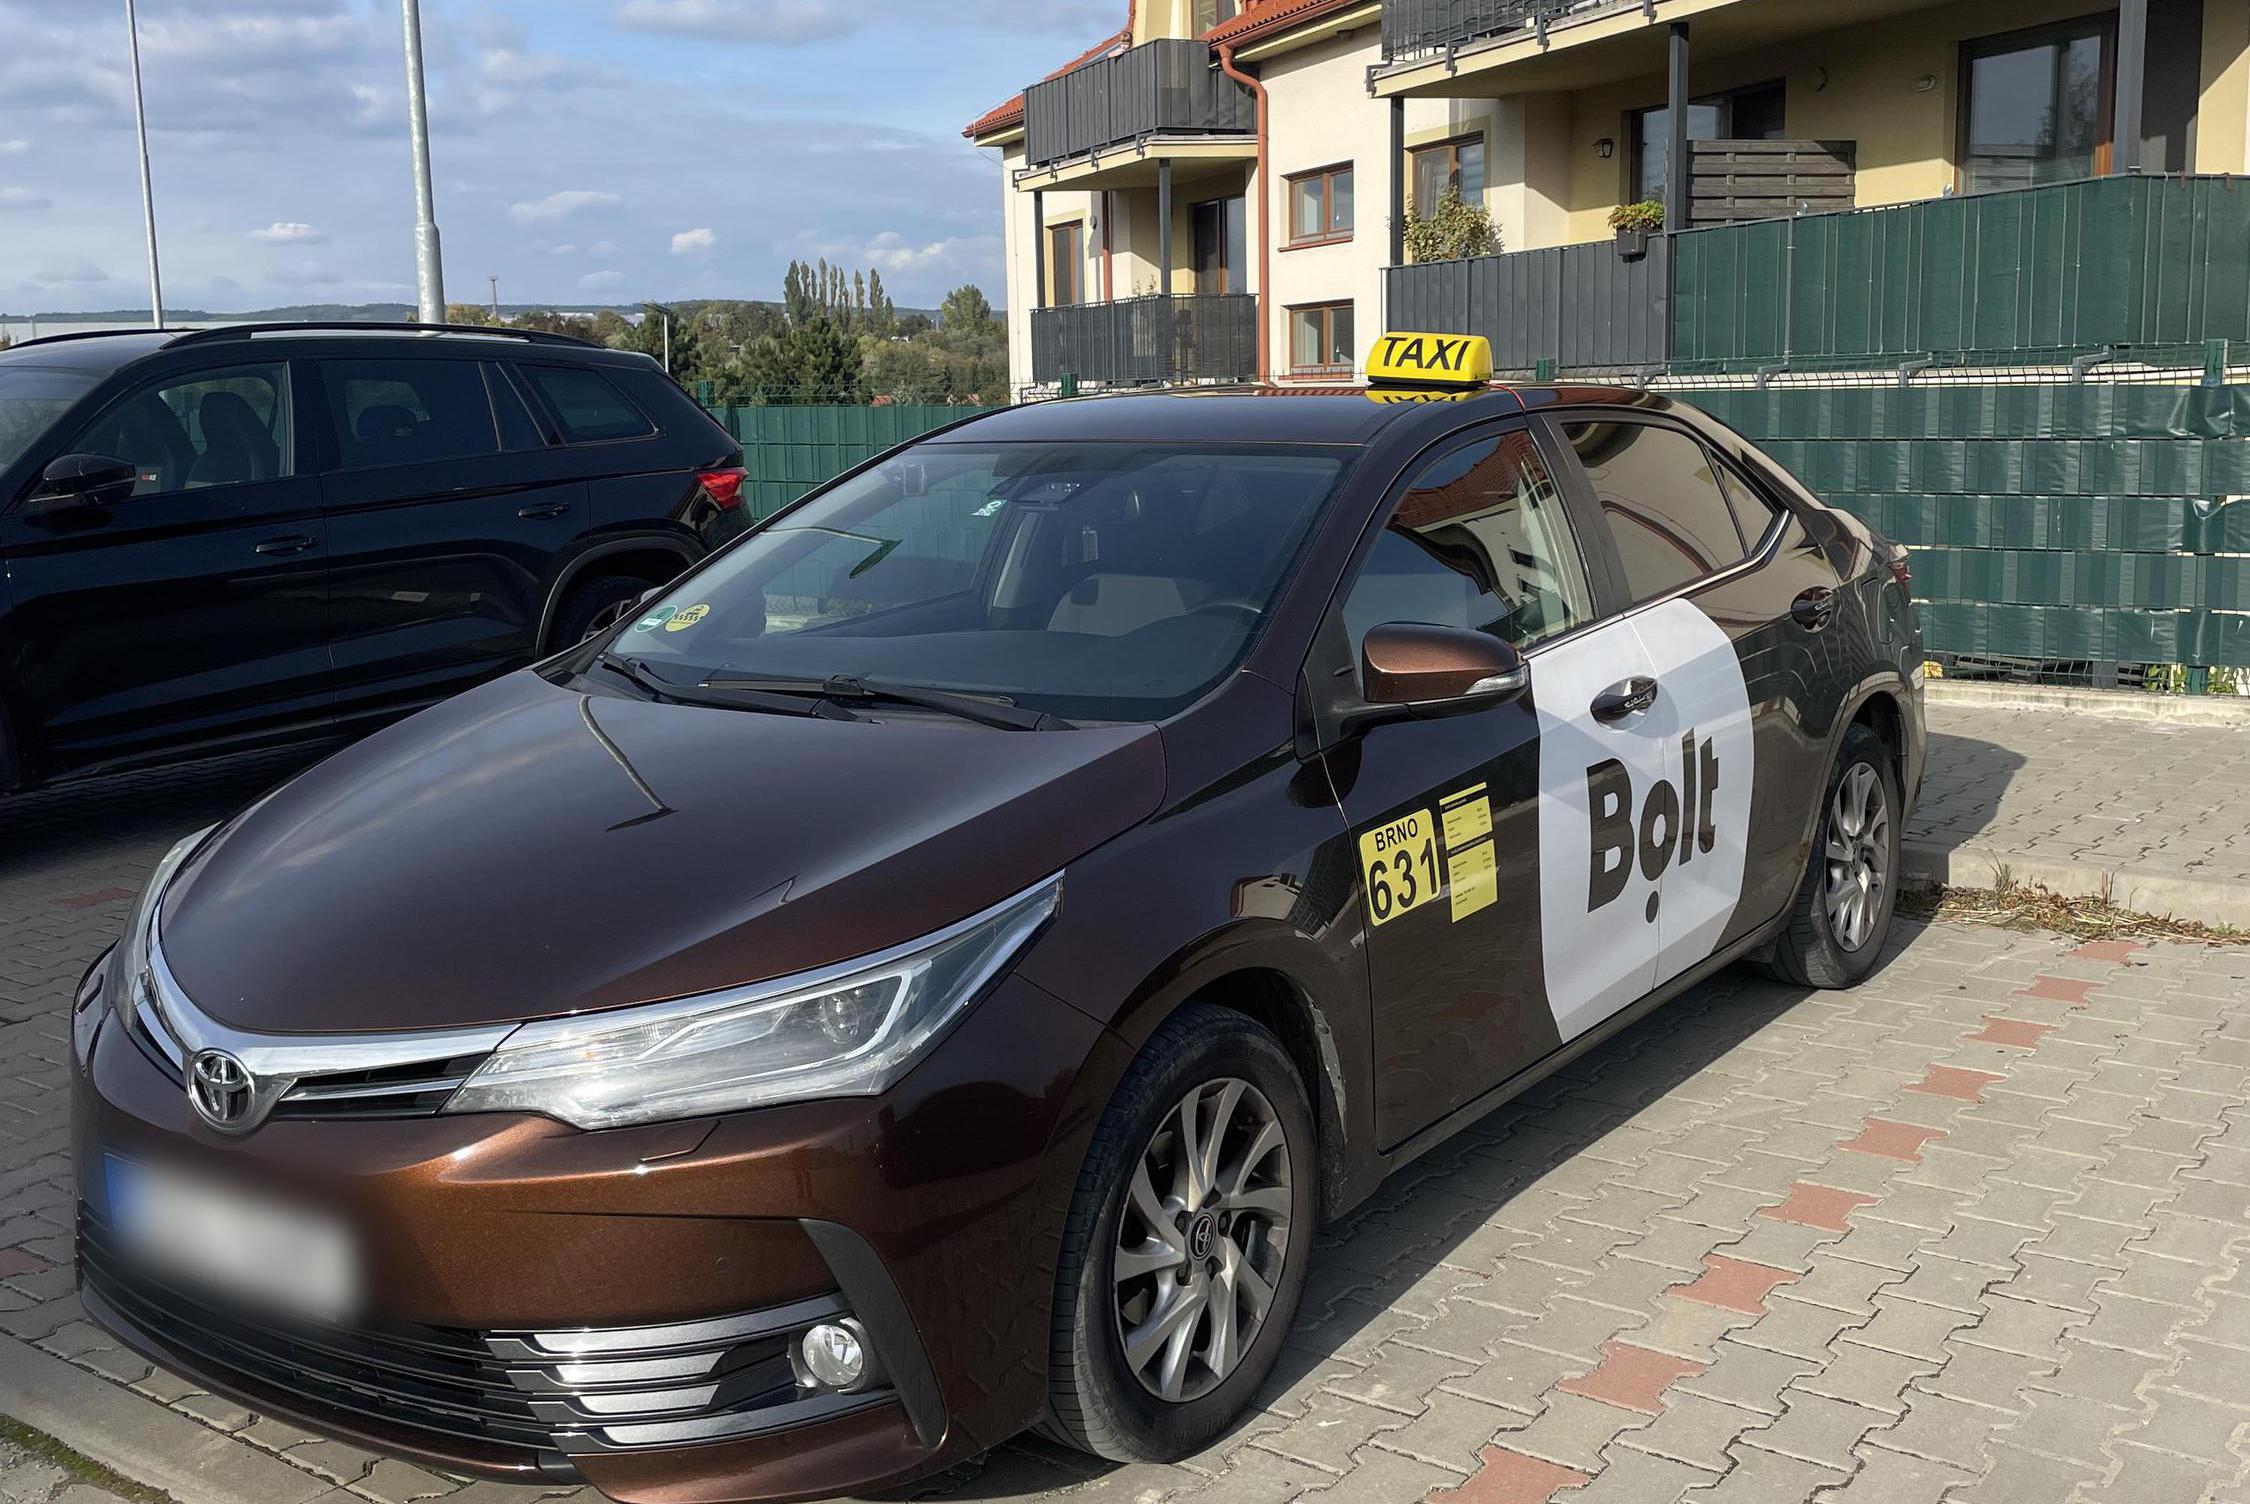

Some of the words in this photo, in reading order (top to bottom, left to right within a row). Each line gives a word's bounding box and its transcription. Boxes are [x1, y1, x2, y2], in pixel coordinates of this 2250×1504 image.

[1383, 336, 1471, 371] TAXI
[1374, 817, 1418, 852] BRNO
[1586, 726, 1719, 924] Bolt
[1369, 837, 1438, 920] 631
